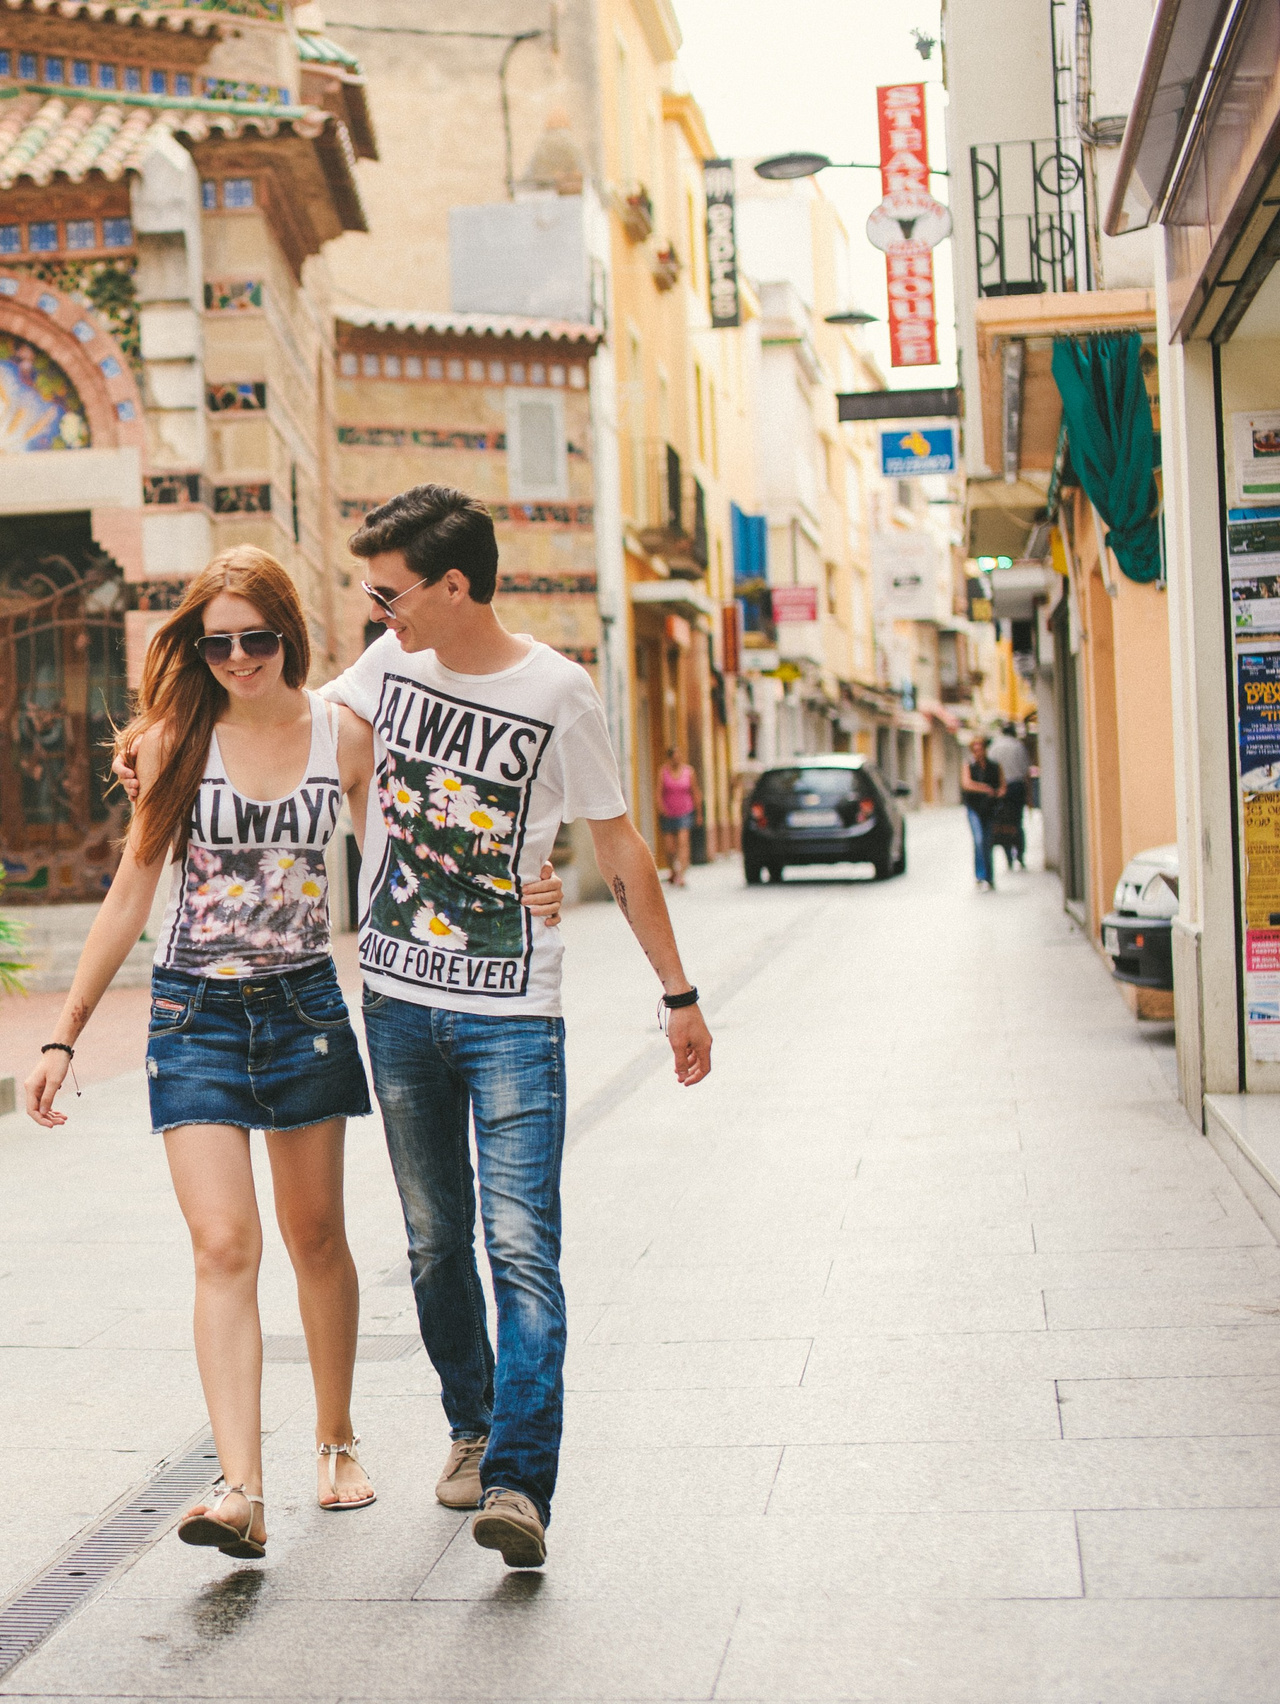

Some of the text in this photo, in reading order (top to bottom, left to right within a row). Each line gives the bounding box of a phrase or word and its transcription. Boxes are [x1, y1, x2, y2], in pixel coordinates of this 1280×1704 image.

[883, 86, 929, 195] STEAK
[889, 255, 933, 364] HOUSE
[378, 686, 537, 782] ALWAYS
[191, 788, 340, 845] ALWAYS
[359, 932, 518, 990] AND FOREVER
